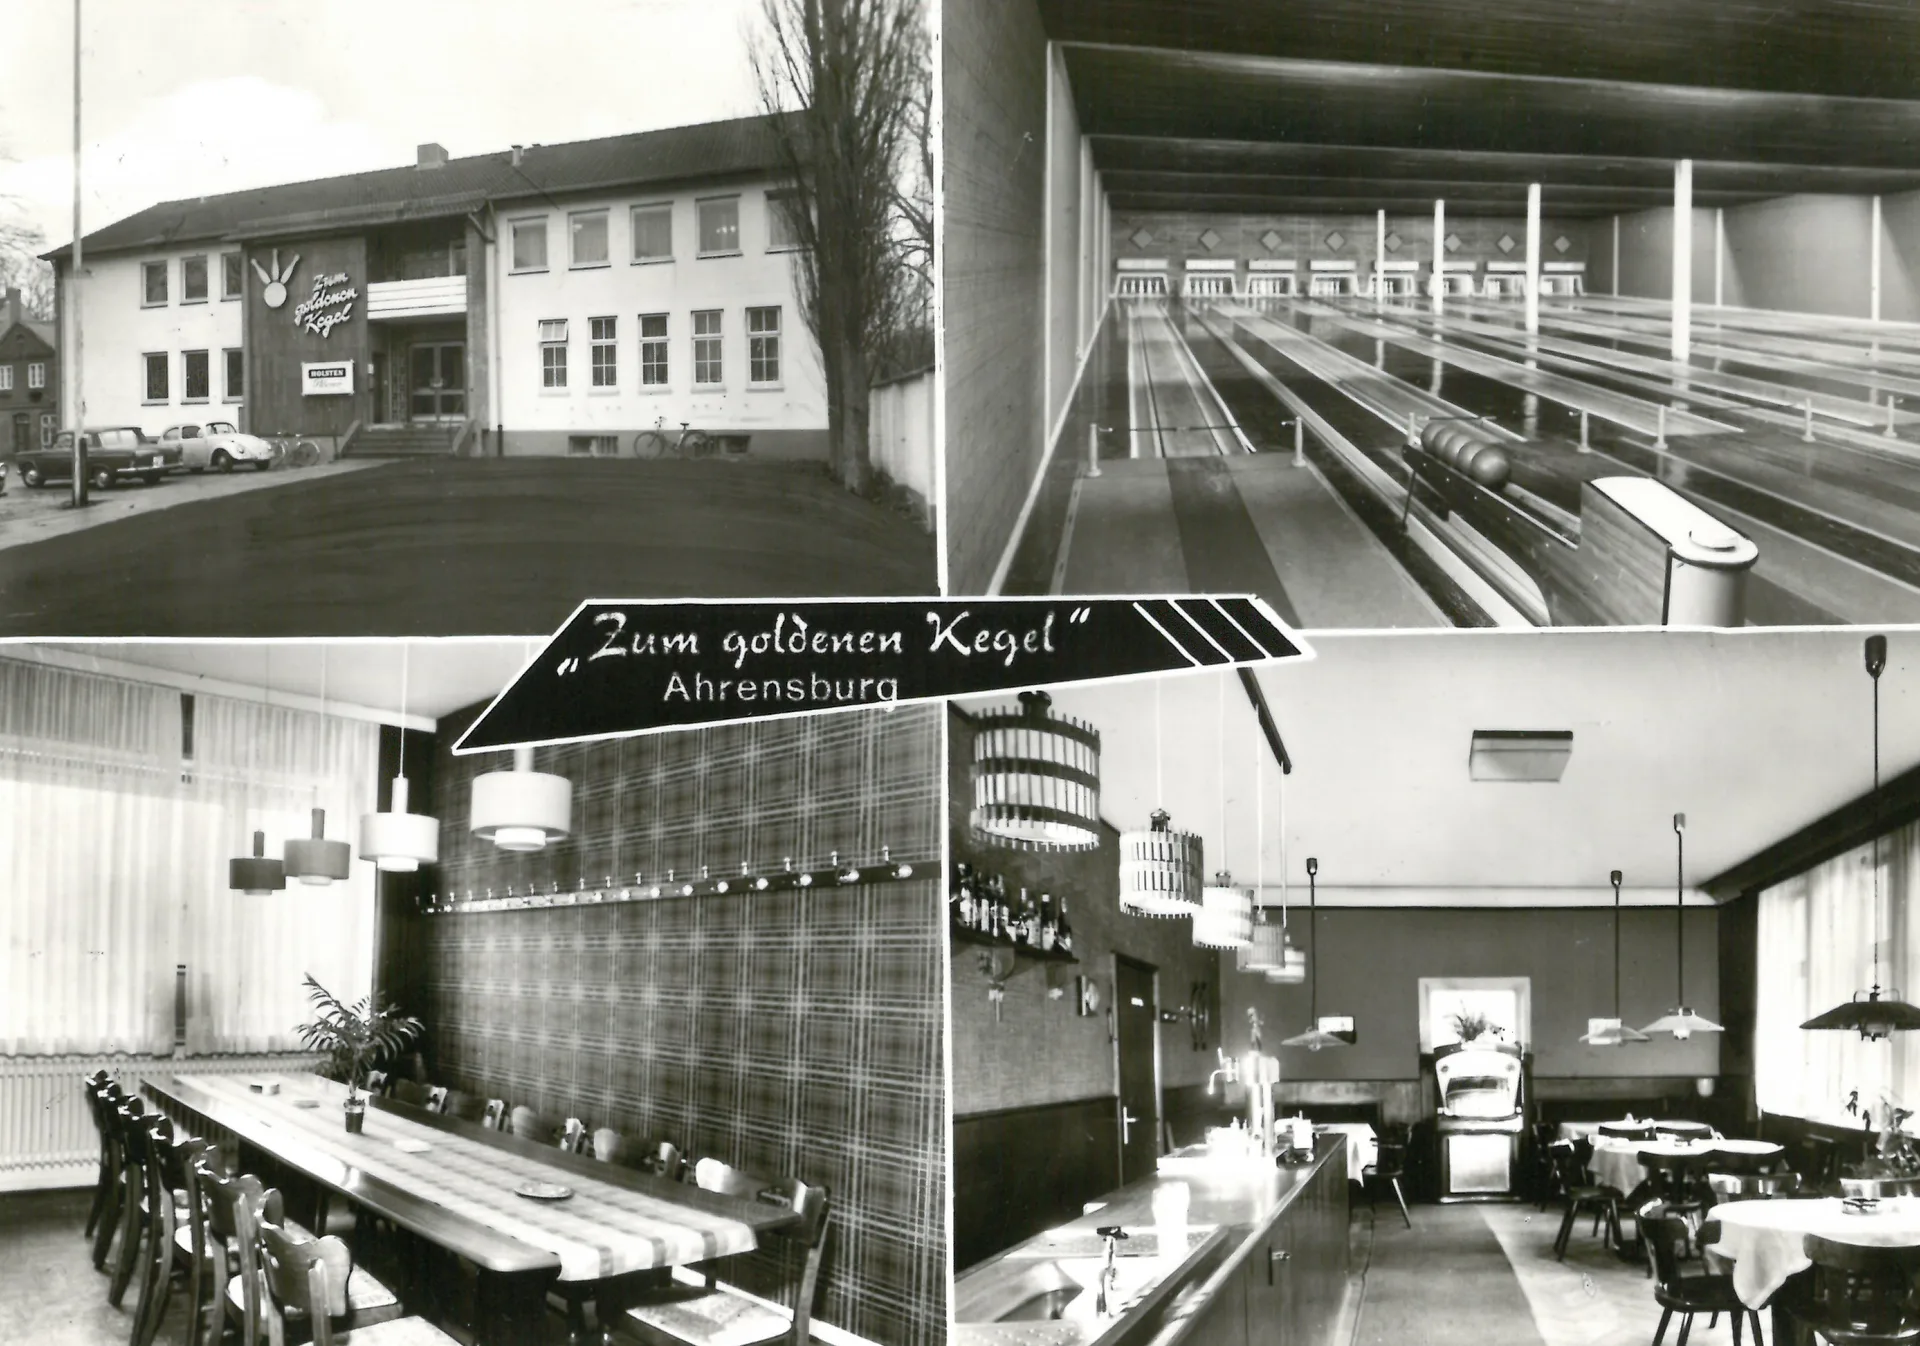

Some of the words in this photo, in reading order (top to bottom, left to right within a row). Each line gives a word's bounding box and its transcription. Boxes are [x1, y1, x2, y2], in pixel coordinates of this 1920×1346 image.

[312, 273, 349, 291] Zum
[294, 288, 358, 327] goldenen
[304, 302, 352, 338] Kegel
[310, 369, 344, 377] HOLSTEN
